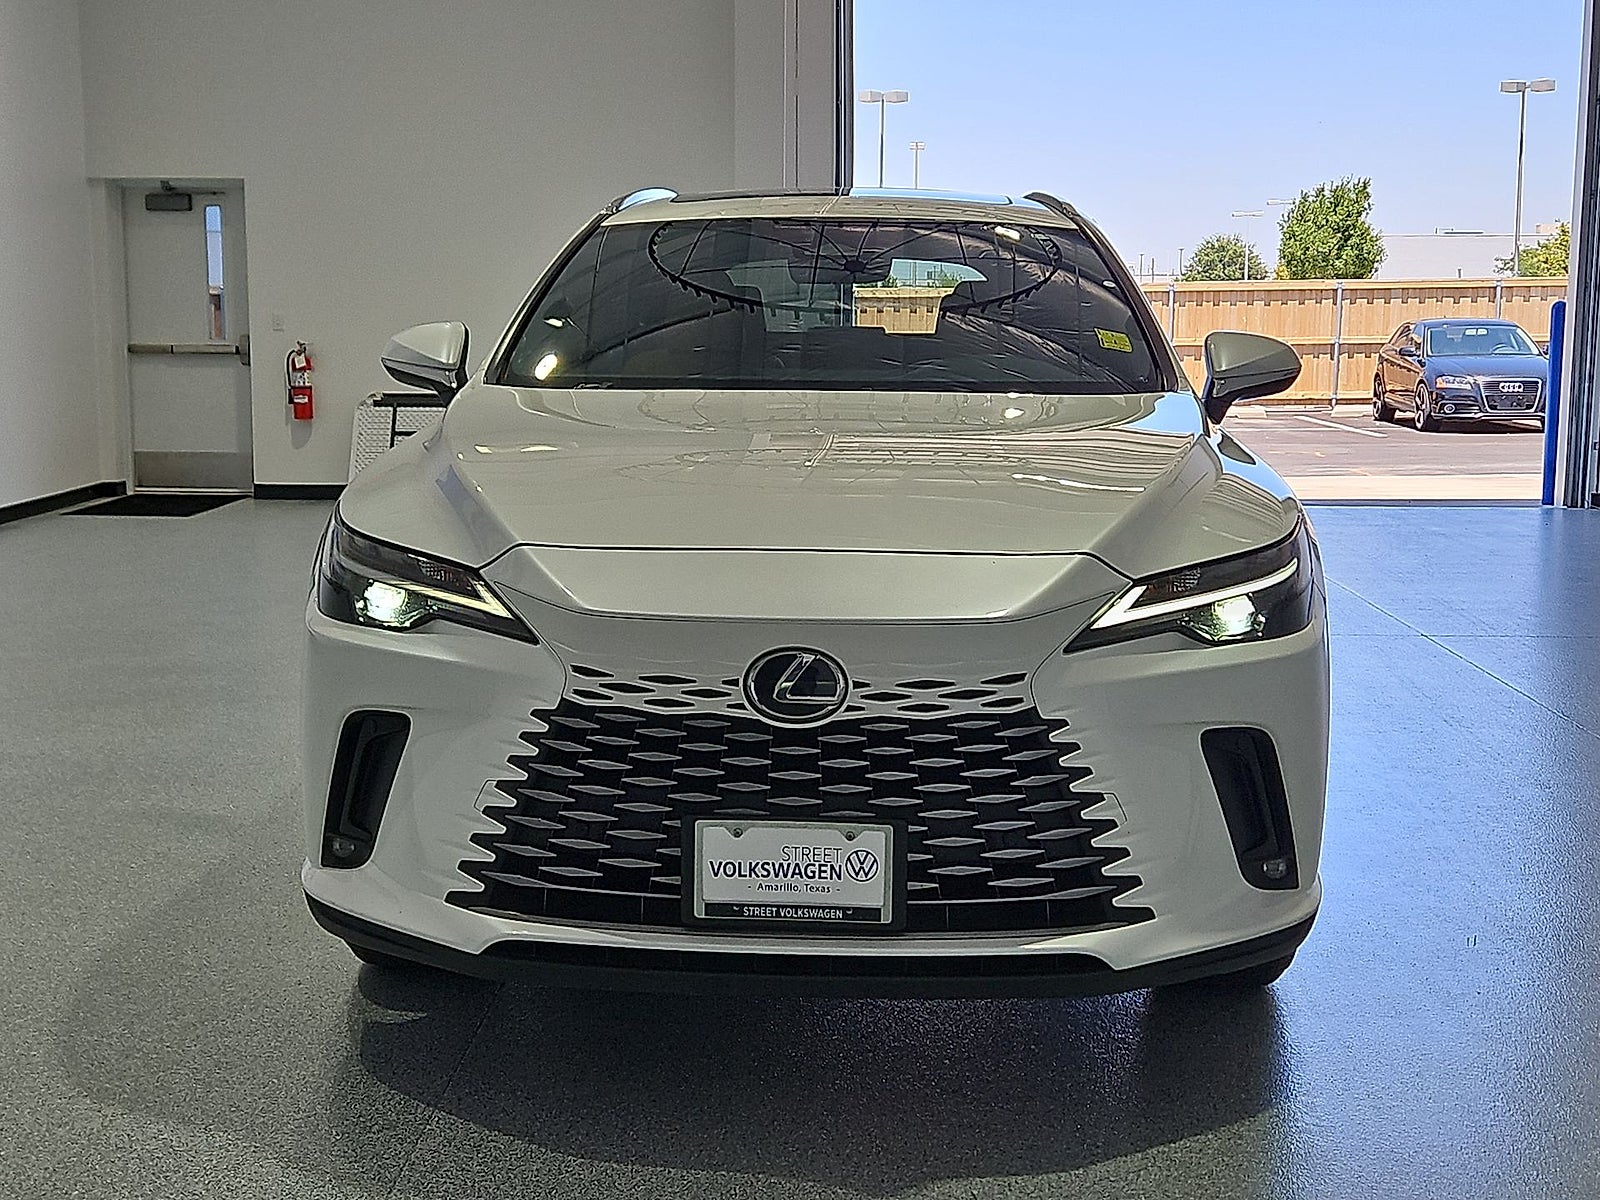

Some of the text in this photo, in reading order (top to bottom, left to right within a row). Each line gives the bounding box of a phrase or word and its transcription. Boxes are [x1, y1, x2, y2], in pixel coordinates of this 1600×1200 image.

[781, 846, 843, 863] STREET
[709, 861, 843, 881] VOLKSWAGEN
[757, 882, 802, 893] Amarillo,
[804, 884, 831, 894] Texas
[743, 906, 843, 919] STREET VOLKSWAGEN
